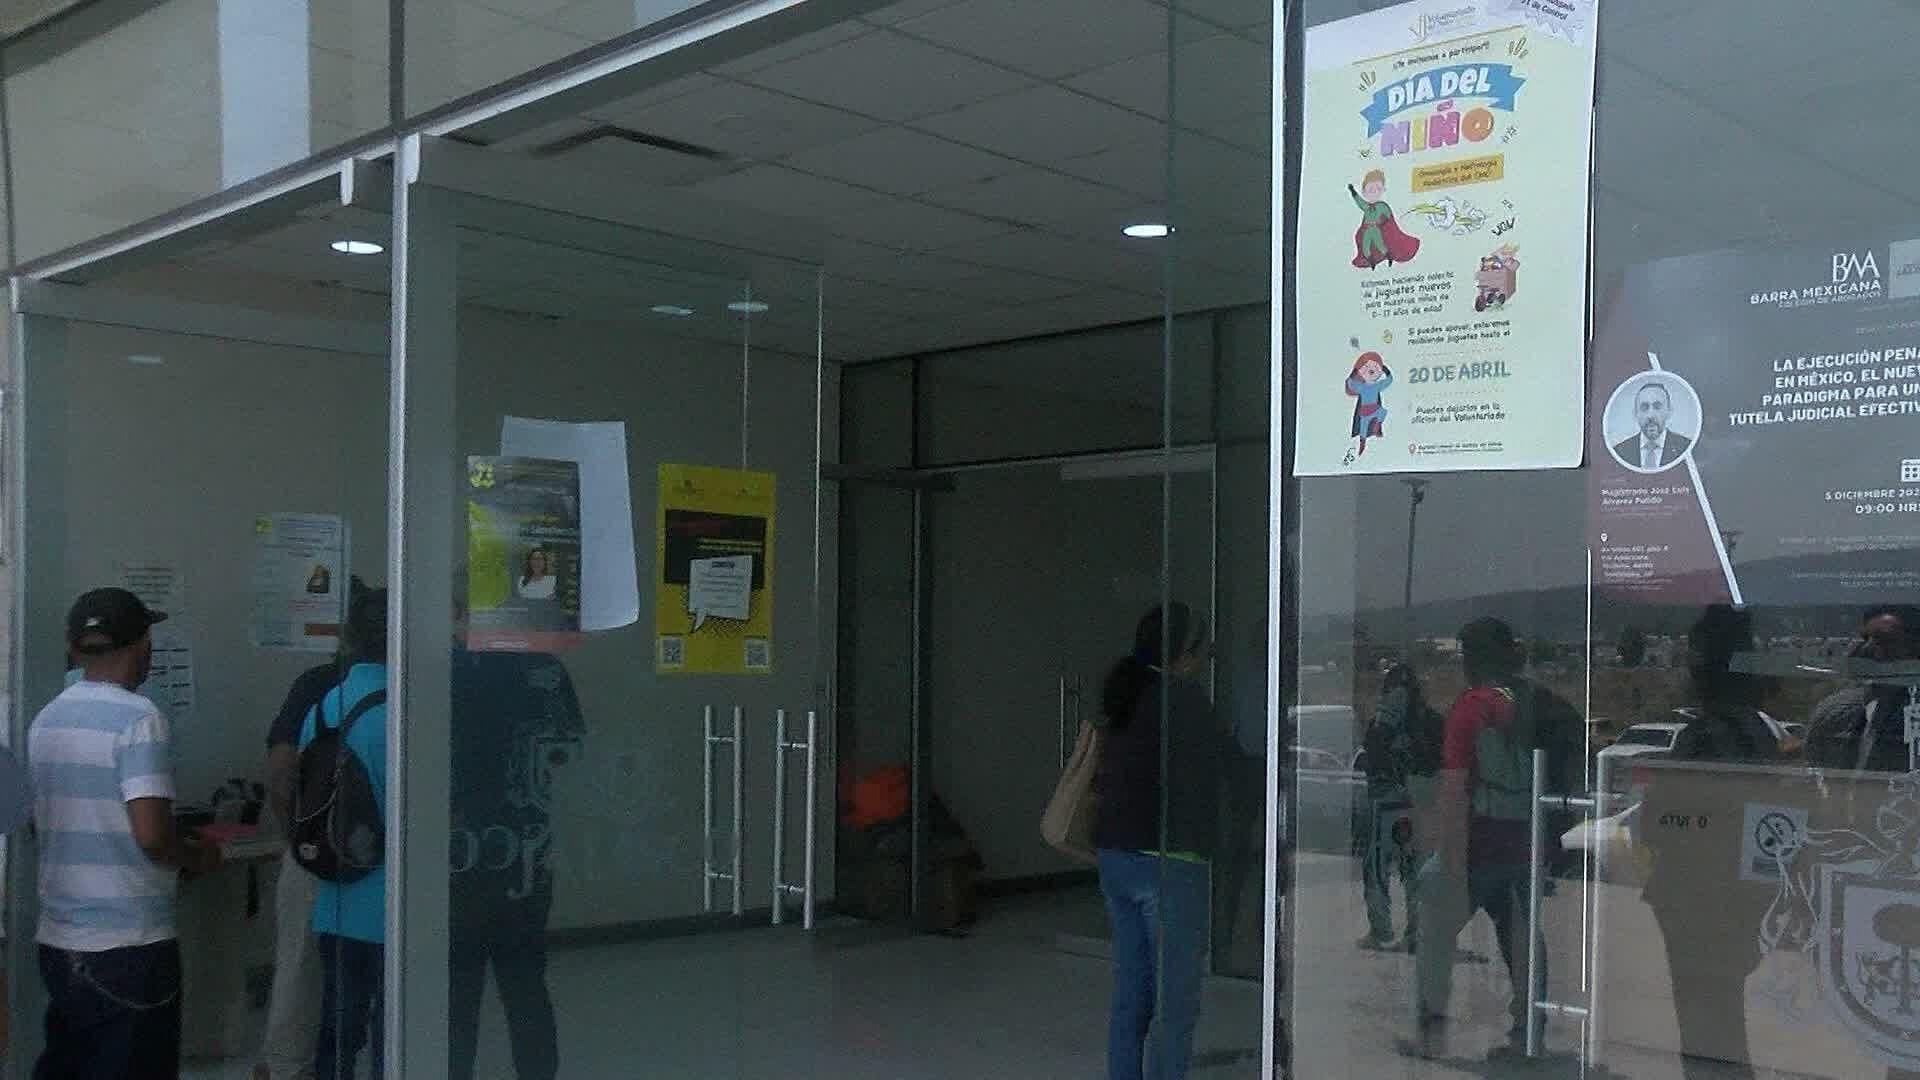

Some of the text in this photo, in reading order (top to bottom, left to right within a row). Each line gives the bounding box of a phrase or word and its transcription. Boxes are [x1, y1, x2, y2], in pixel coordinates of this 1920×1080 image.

[1380, 98, 1495, 157] NIÑO
[1831, 249, 1881, 284] BMA
[1391, 273, 1425, 285] haciendo
[1363, 281, 1452, 300] de juguetes nuevos
[1750, 279, 1882, 306] BARRA MEXICANA
[1383, 297, 1415, 307] nuestros
[1393, 306, 1409, 317] años
[1411, 306, 1422, 315] de
[1423, 303, 1443, 313] edad
[1417, 326, 1443, 336] puedes
[1473, 319, 1510, 330] estaremos
[1408, 329, 1511, 346] recibiendo juguetes hasta el
[1773, 359, 1794, 374] LA
[1796, 348, 1881, 370] EJECUCIÓN
[1408, 360, 1513, 384] 20 DE ABRIL
[1774, 375, 1799, 389] EN
[1800, 369, 1858, 388] MÉXICO,
[1861, 367, 1881, 382] EL
[1762, 388, 1850, 407] PARADIGMA
[1854, 384, 1899, 400] PARA
[1410, 411, 1506, 424] oficina del Voluntariado
[1416, 406, 1444, 415] Puedes
[1446, 404, 1478, 415] dejarlos
[1480, 403, 1490, 411] en
[1729, 409, 1785, 426] TUTELA
[1786, 404, 1857, 423] JUDICIAL
[1824, 491, 1832, 501] 5
[1834, 488, 1896, 501] DICIEMBRE
[1855, 502, 1895, 514] 09:00
